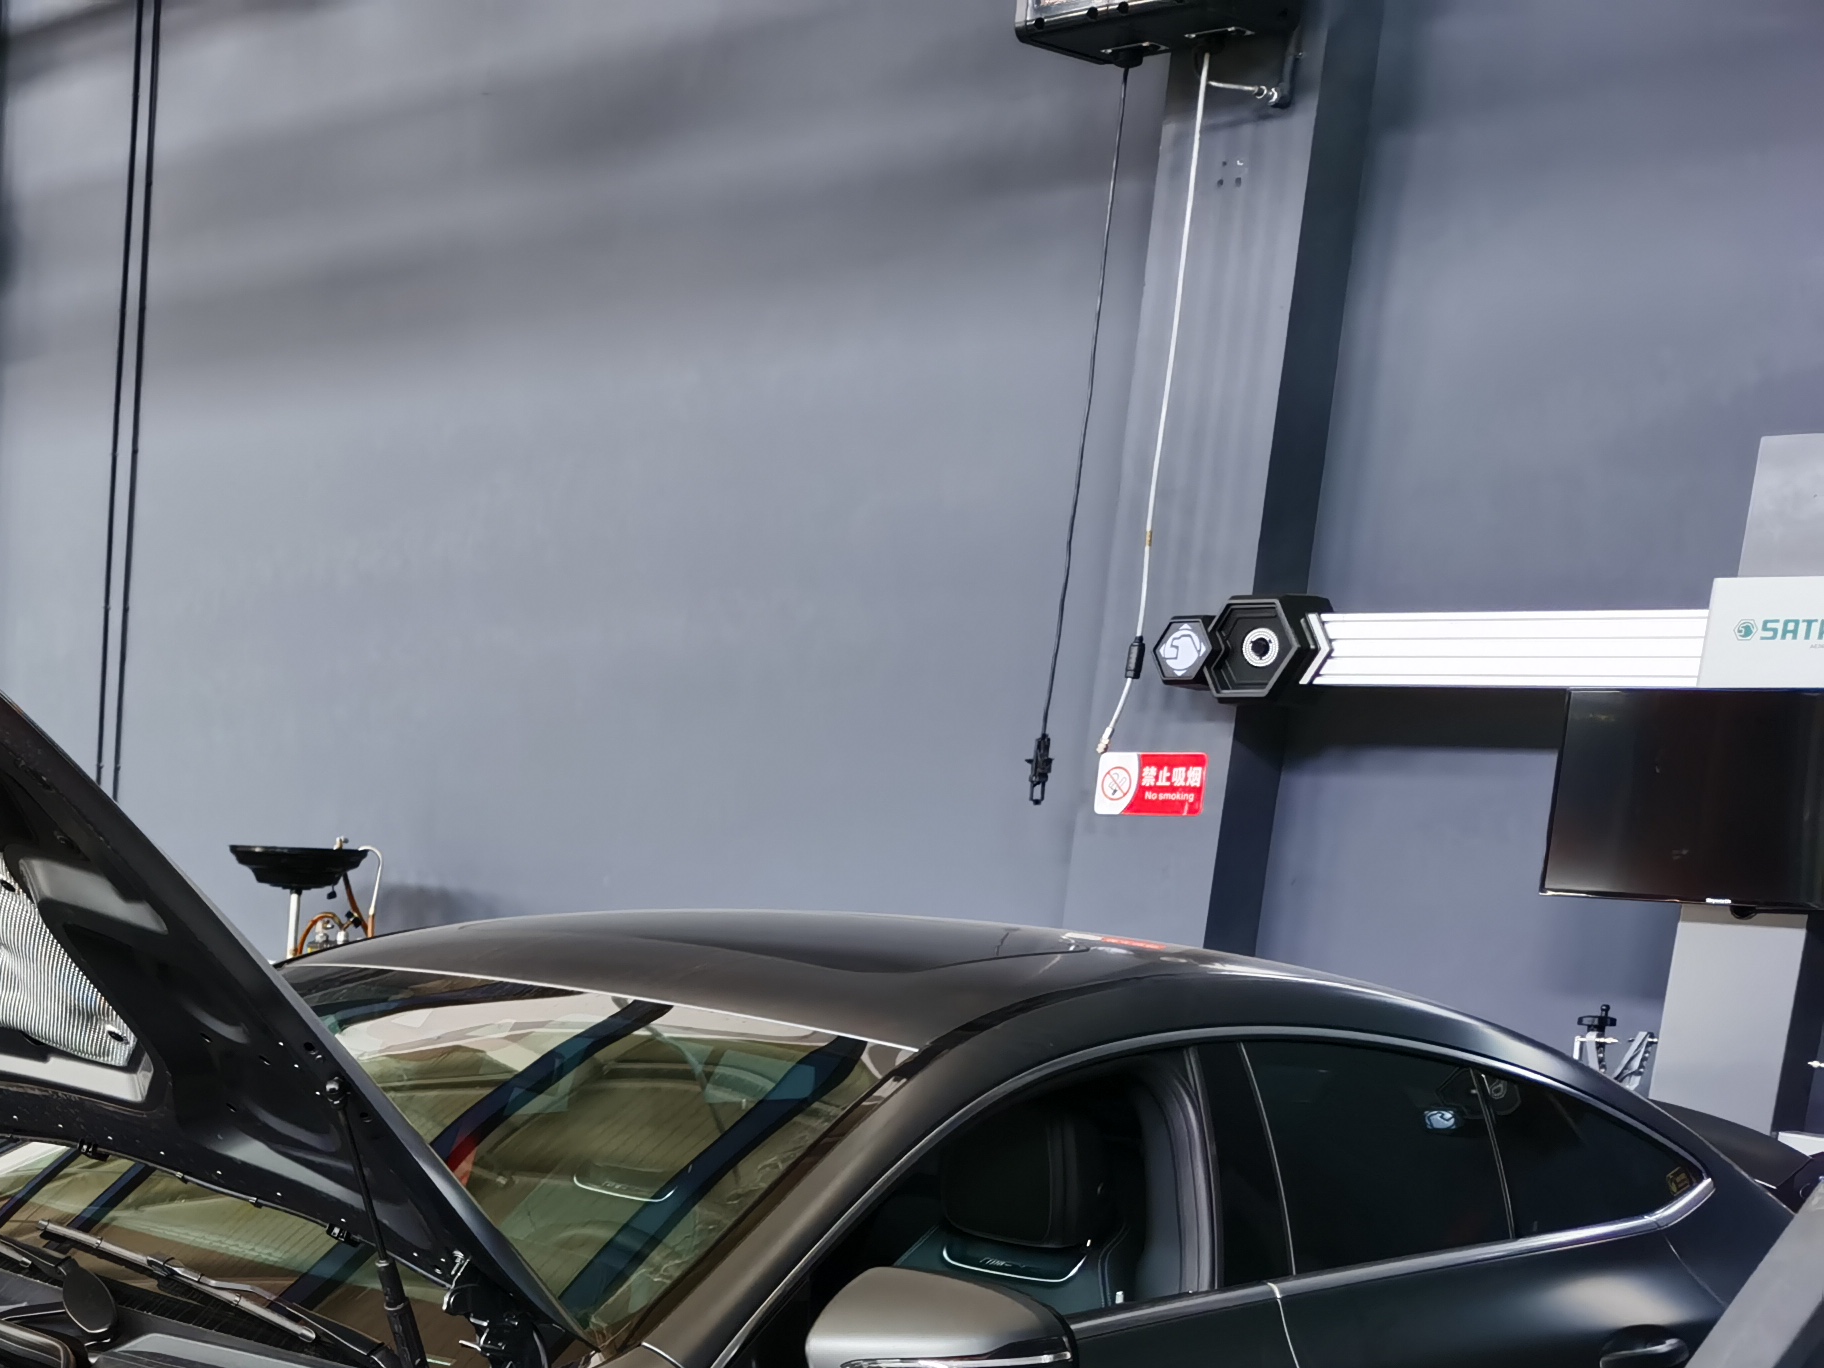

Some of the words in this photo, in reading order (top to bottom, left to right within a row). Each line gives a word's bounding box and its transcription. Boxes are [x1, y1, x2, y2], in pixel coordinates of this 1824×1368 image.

[1141, 766, 1203, 787] 禁止吸烟
[1144, 791, 1158, 800] No
[1159, 791, 1195, 803] smoking
